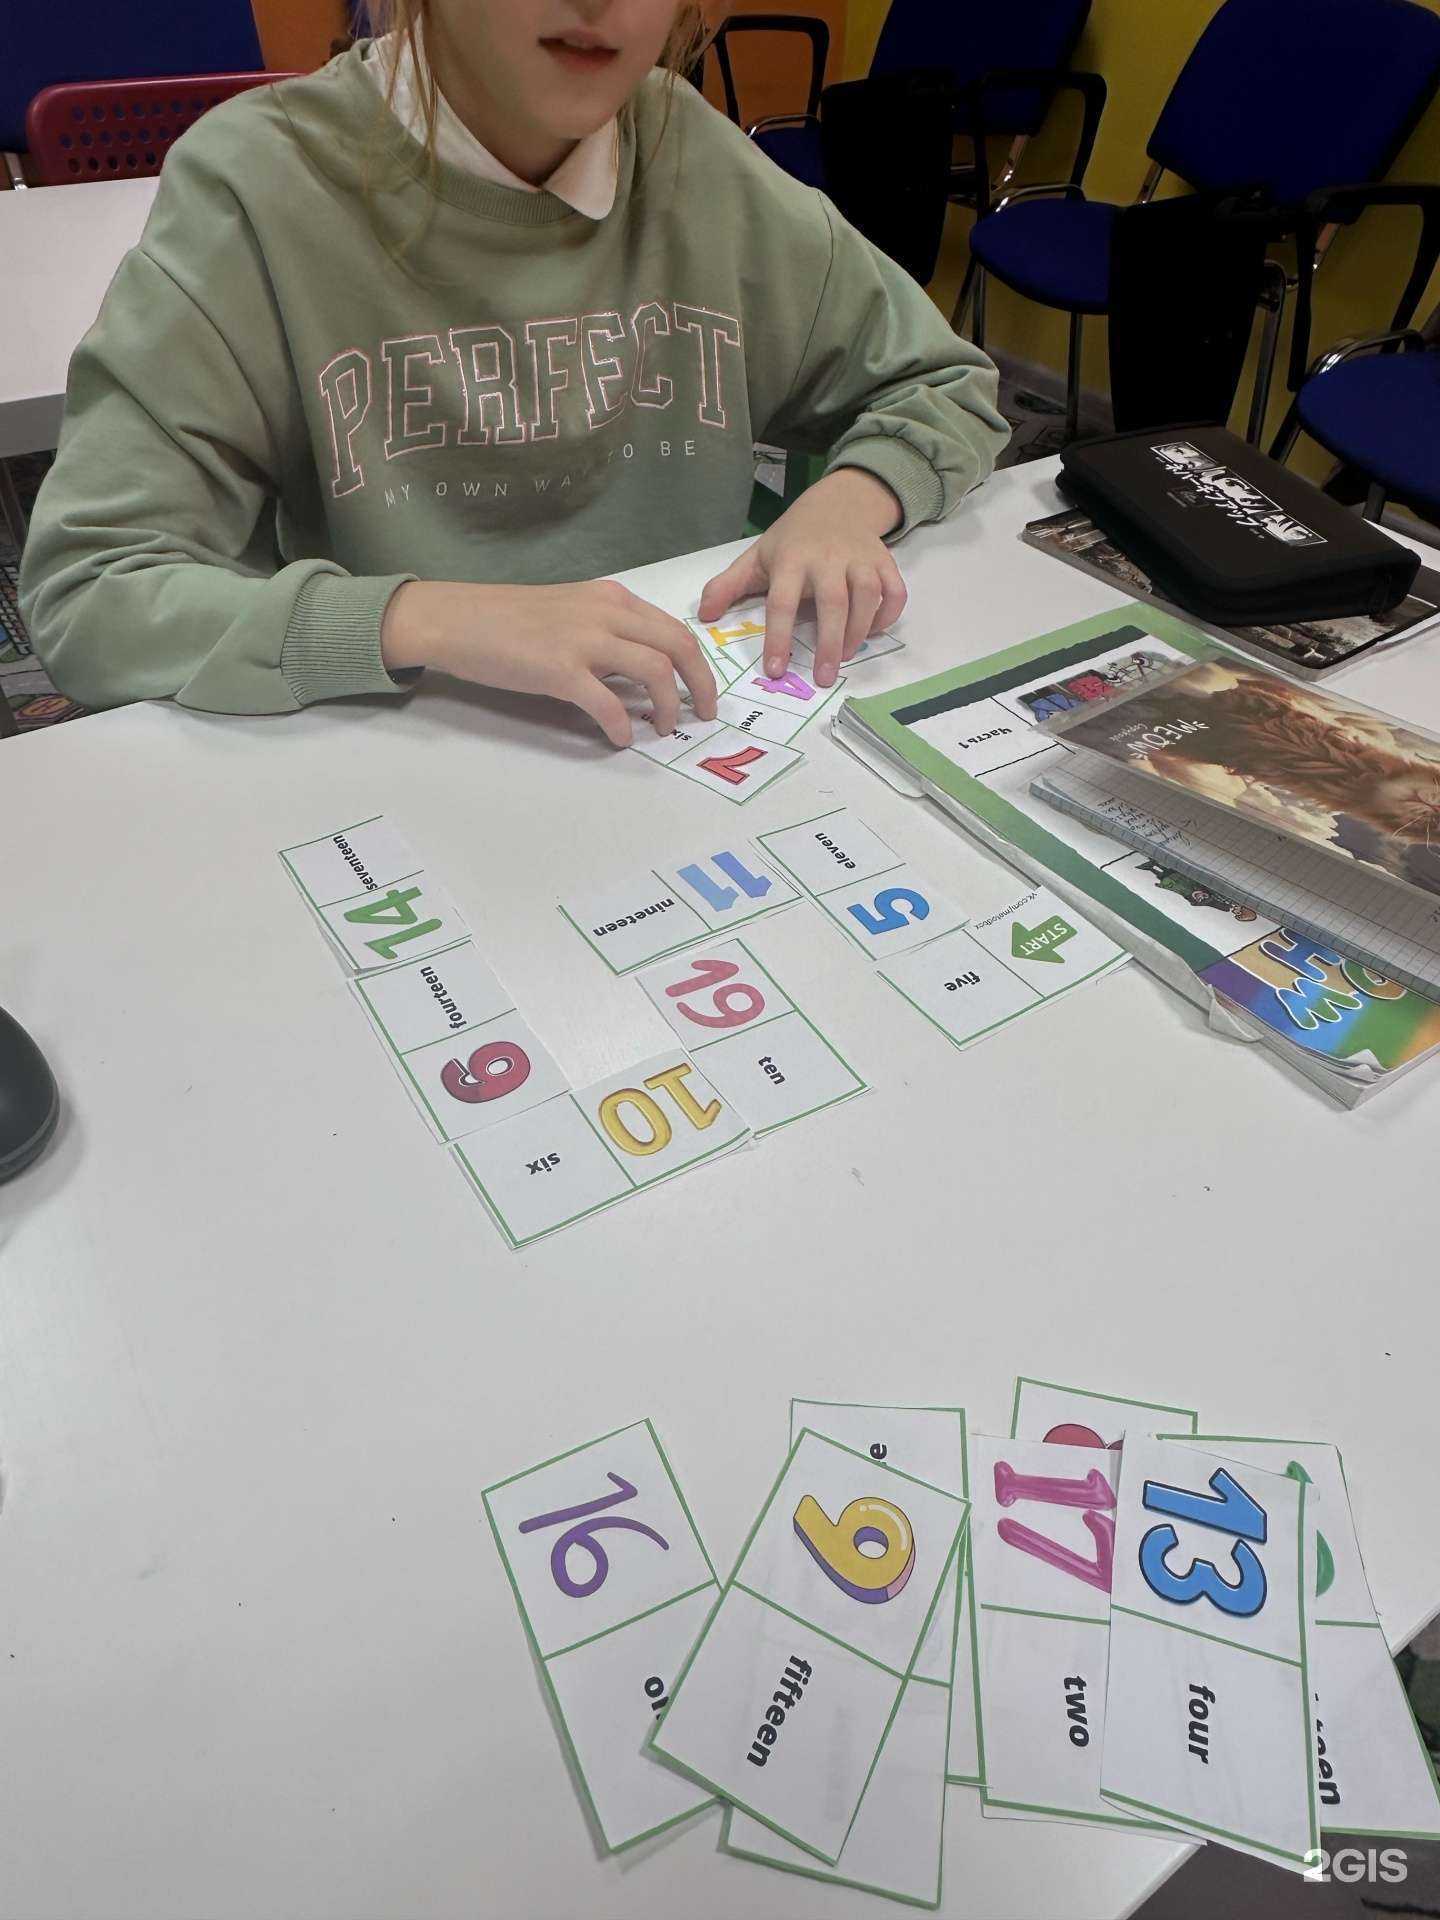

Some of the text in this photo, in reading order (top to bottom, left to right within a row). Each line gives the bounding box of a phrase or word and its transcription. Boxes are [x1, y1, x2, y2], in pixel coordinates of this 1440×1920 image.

[320, 302, 740, 498] PERFECT
[384, 483, 410, 508] MY
[436, 481, 508, 498] OWN
[660, 440, 696, 456] BE
[697, 746, 768, 785] 7
[1126, 719, 1198, 754] MEOW
[333, 834, 378, 891] seventeen
[676, 851, 773, 912] 11
[815, 833, 856, 870] eleven
[343, 886, 443, 960] 14
[593, 899, 675, 937] nineteen
[847, 888, 930, 935] 5
[1020, 923, 1067, 955] START
[420, 967, 467, 1029] fourteen
[665, 959, 766, 1028] 19
[944, 969, 981, 993] five
[758, 1056, 786, 1086] ten
[598, 1063, 722, 1156] 10
[524, 1152, 561, 1175] six
[518, 1472, 669, 1597] 16
[994, 1460, 1117, 1594] 17
[1139, 1467, 1268, 1617] 13
[747, 1655, 813, 1767] fifteen
[1063, 1674, 1090, 1748] two
[1188, 1684, 1216, 1764] four
